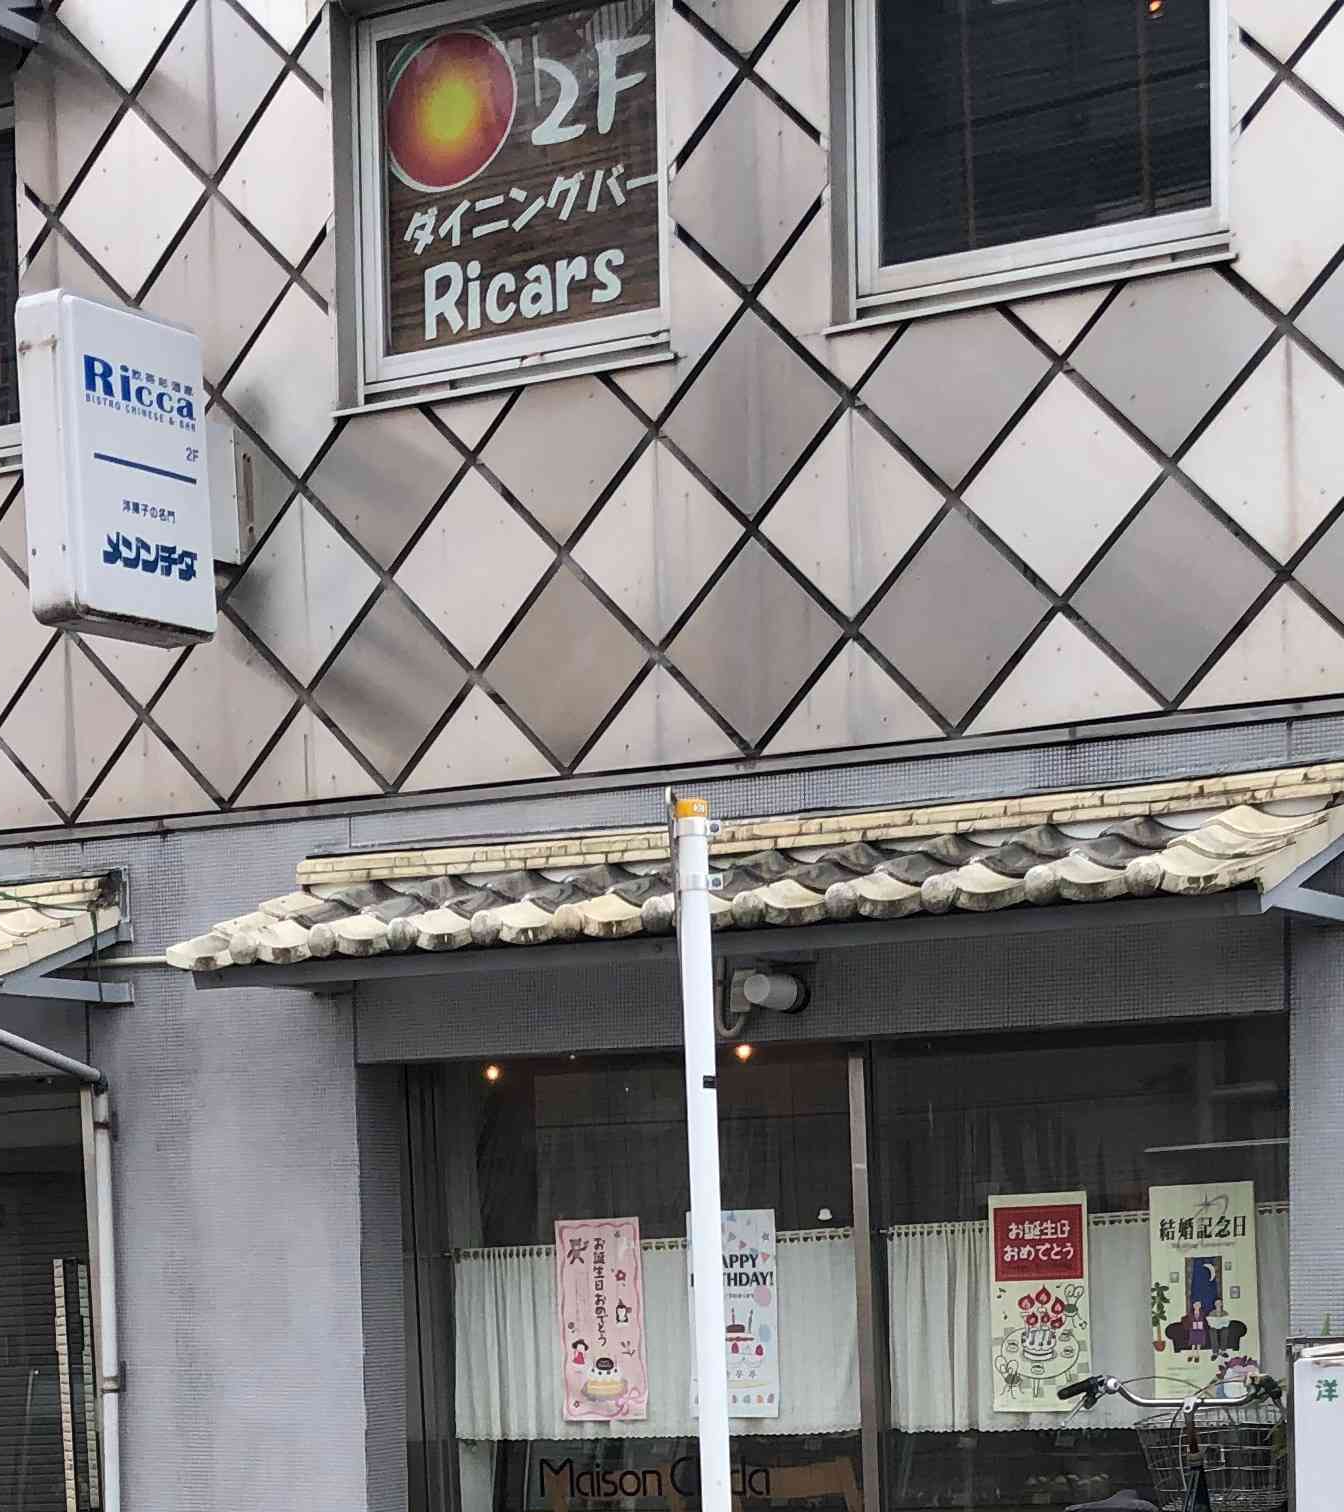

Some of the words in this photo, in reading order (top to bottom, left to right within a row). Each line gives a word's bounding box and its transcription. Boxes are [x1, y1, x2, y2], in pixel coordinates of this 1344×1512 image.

[531, 34, 651, 146] 2F
[403, 163, 657, 255] ダイニングバー
[424, 248, 625, 341] Ricars
[83, 354, 196, 421] Ricca
[186, 447, 199, 462] 2F
[1008, 1220, 1071, 1240] お誕生日
[1159, 1216, 1246, 1241] 結婚記念日
[722, 1254, 759, 1269] APPY
[1003, 1243, 1074, 1261] おめでとう
[593, 1237, 609, 1347] お誕生日おめでとう
[540, 1457, 663, 1498] Maison
[670, 1456, 770, 1497] Cda
